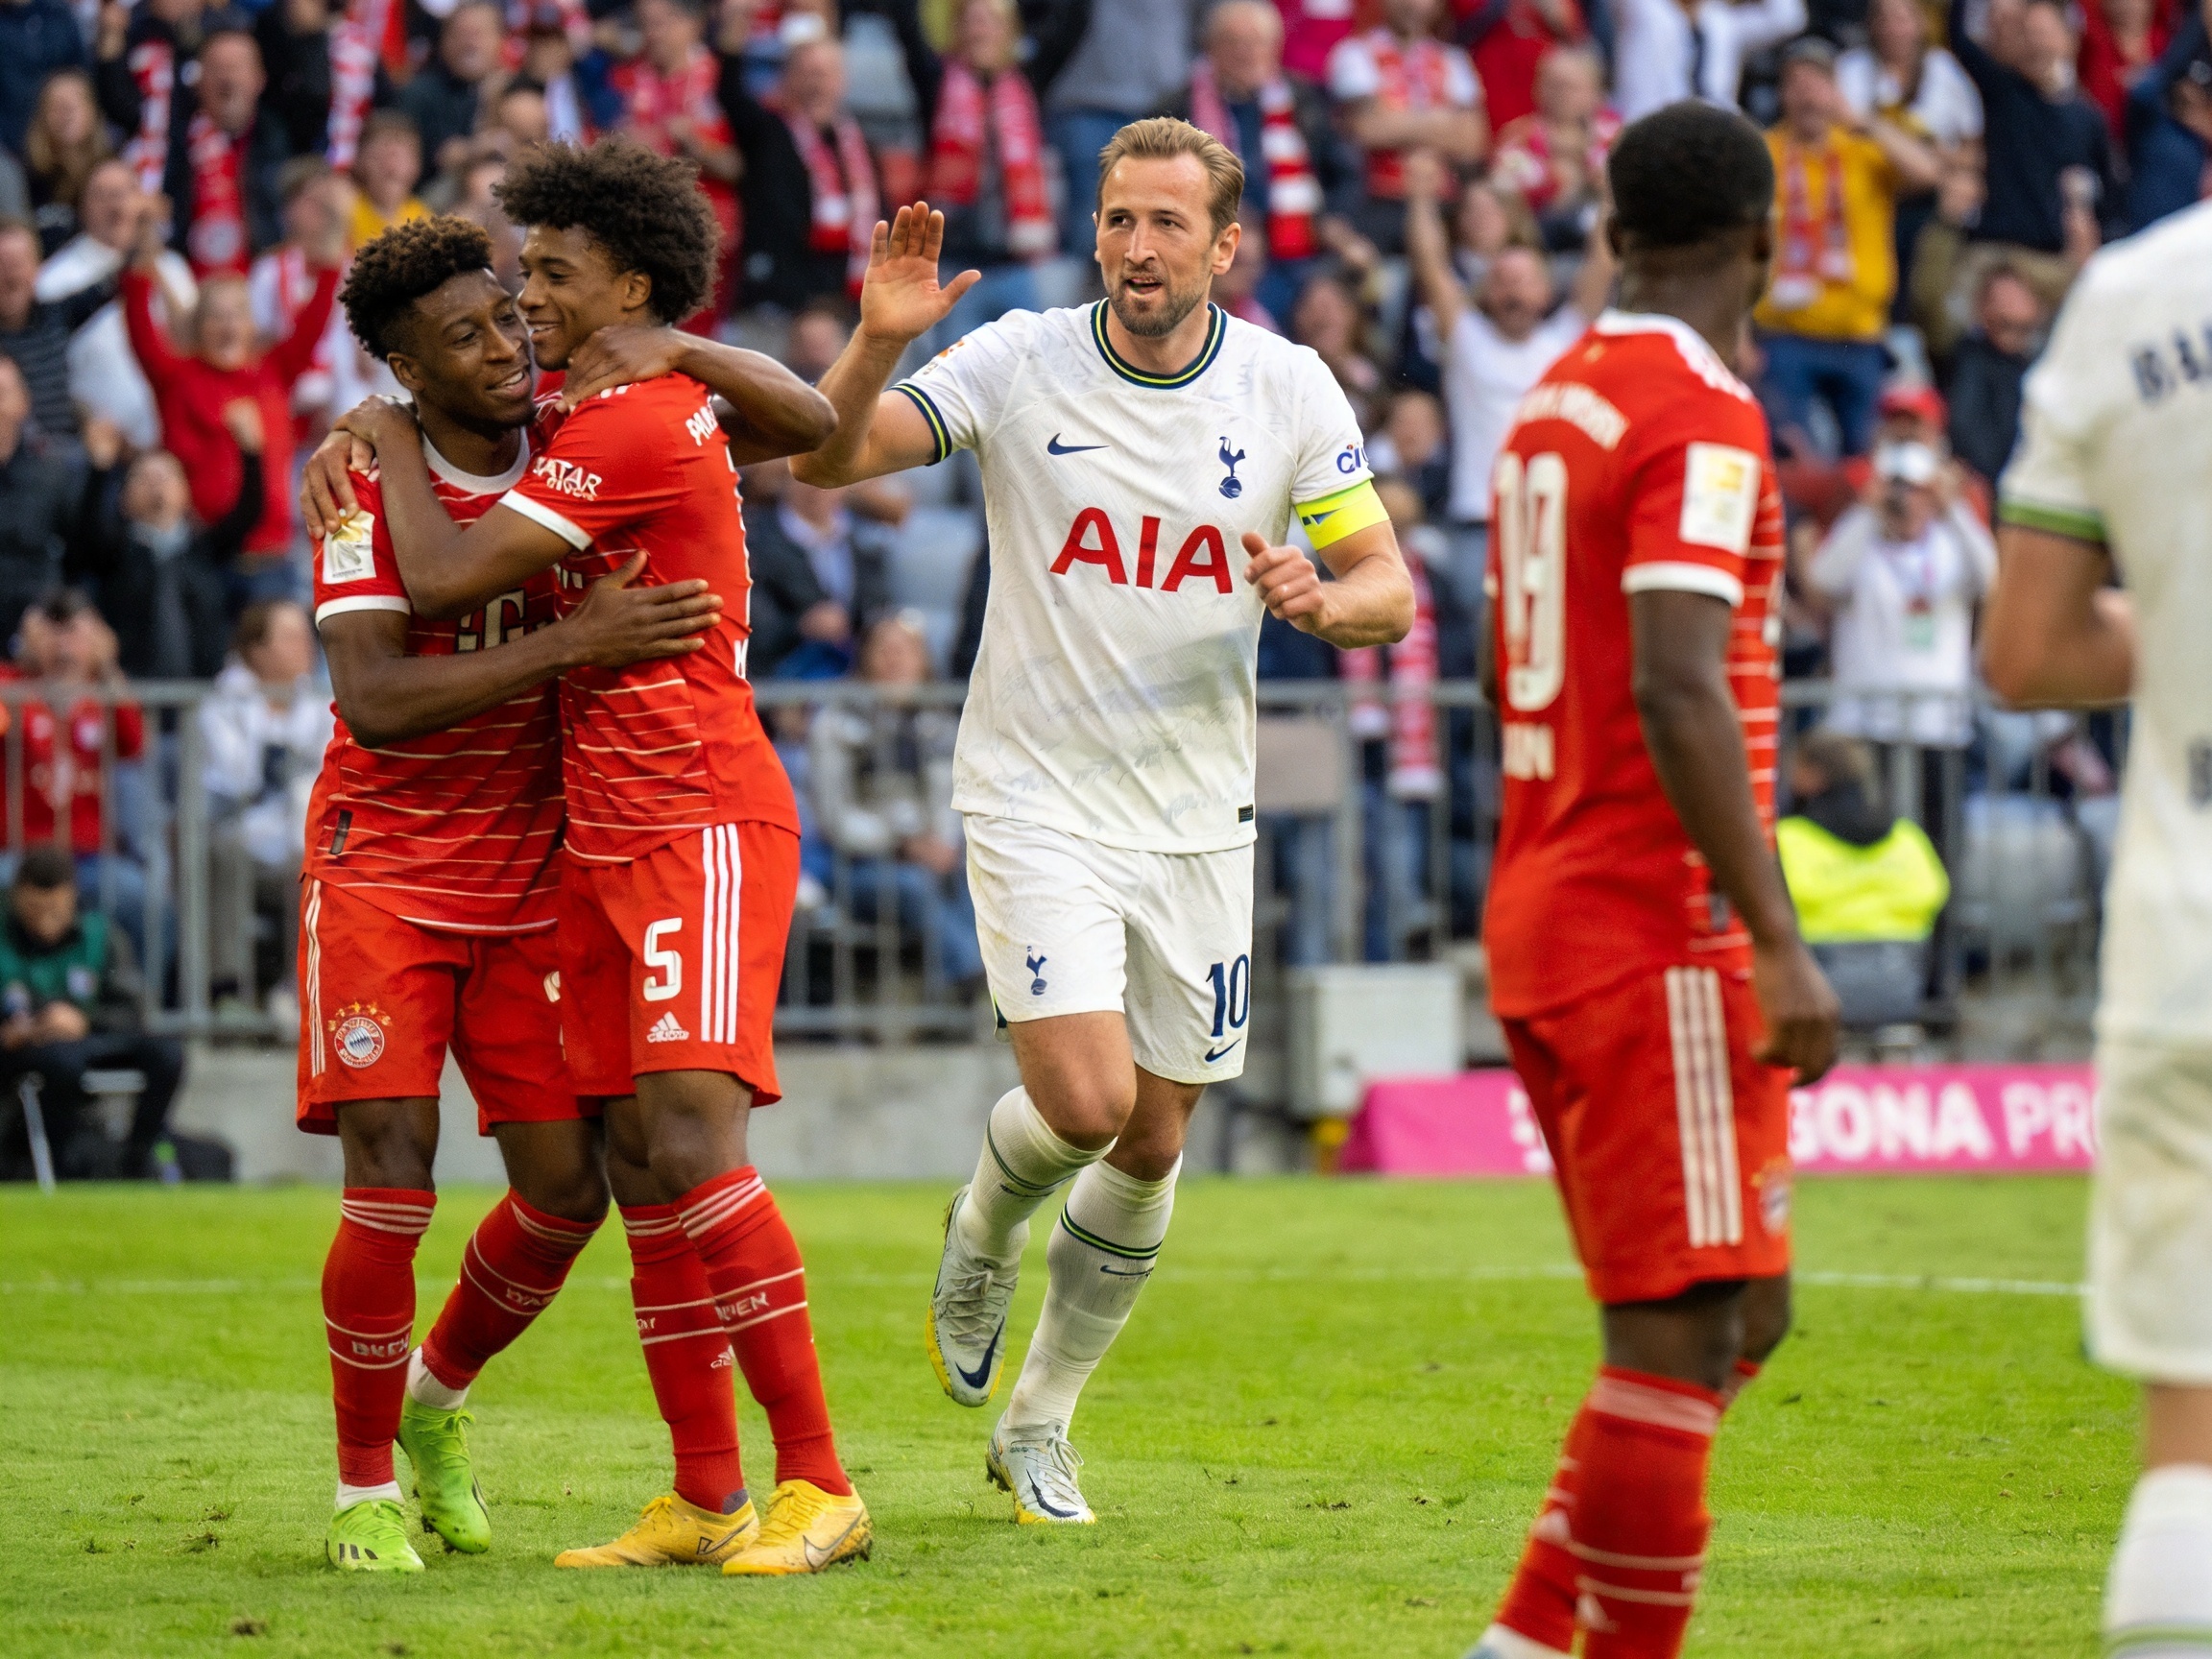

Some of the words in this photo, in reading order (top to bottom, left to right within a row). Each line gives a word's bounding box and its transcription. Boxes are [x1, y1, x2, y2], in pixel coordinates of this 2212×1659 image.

[1049, 507, 1233, 594] AIA
[643, 917, 683, 1002] 5
[1206, 953, 1249, 1037] 10
